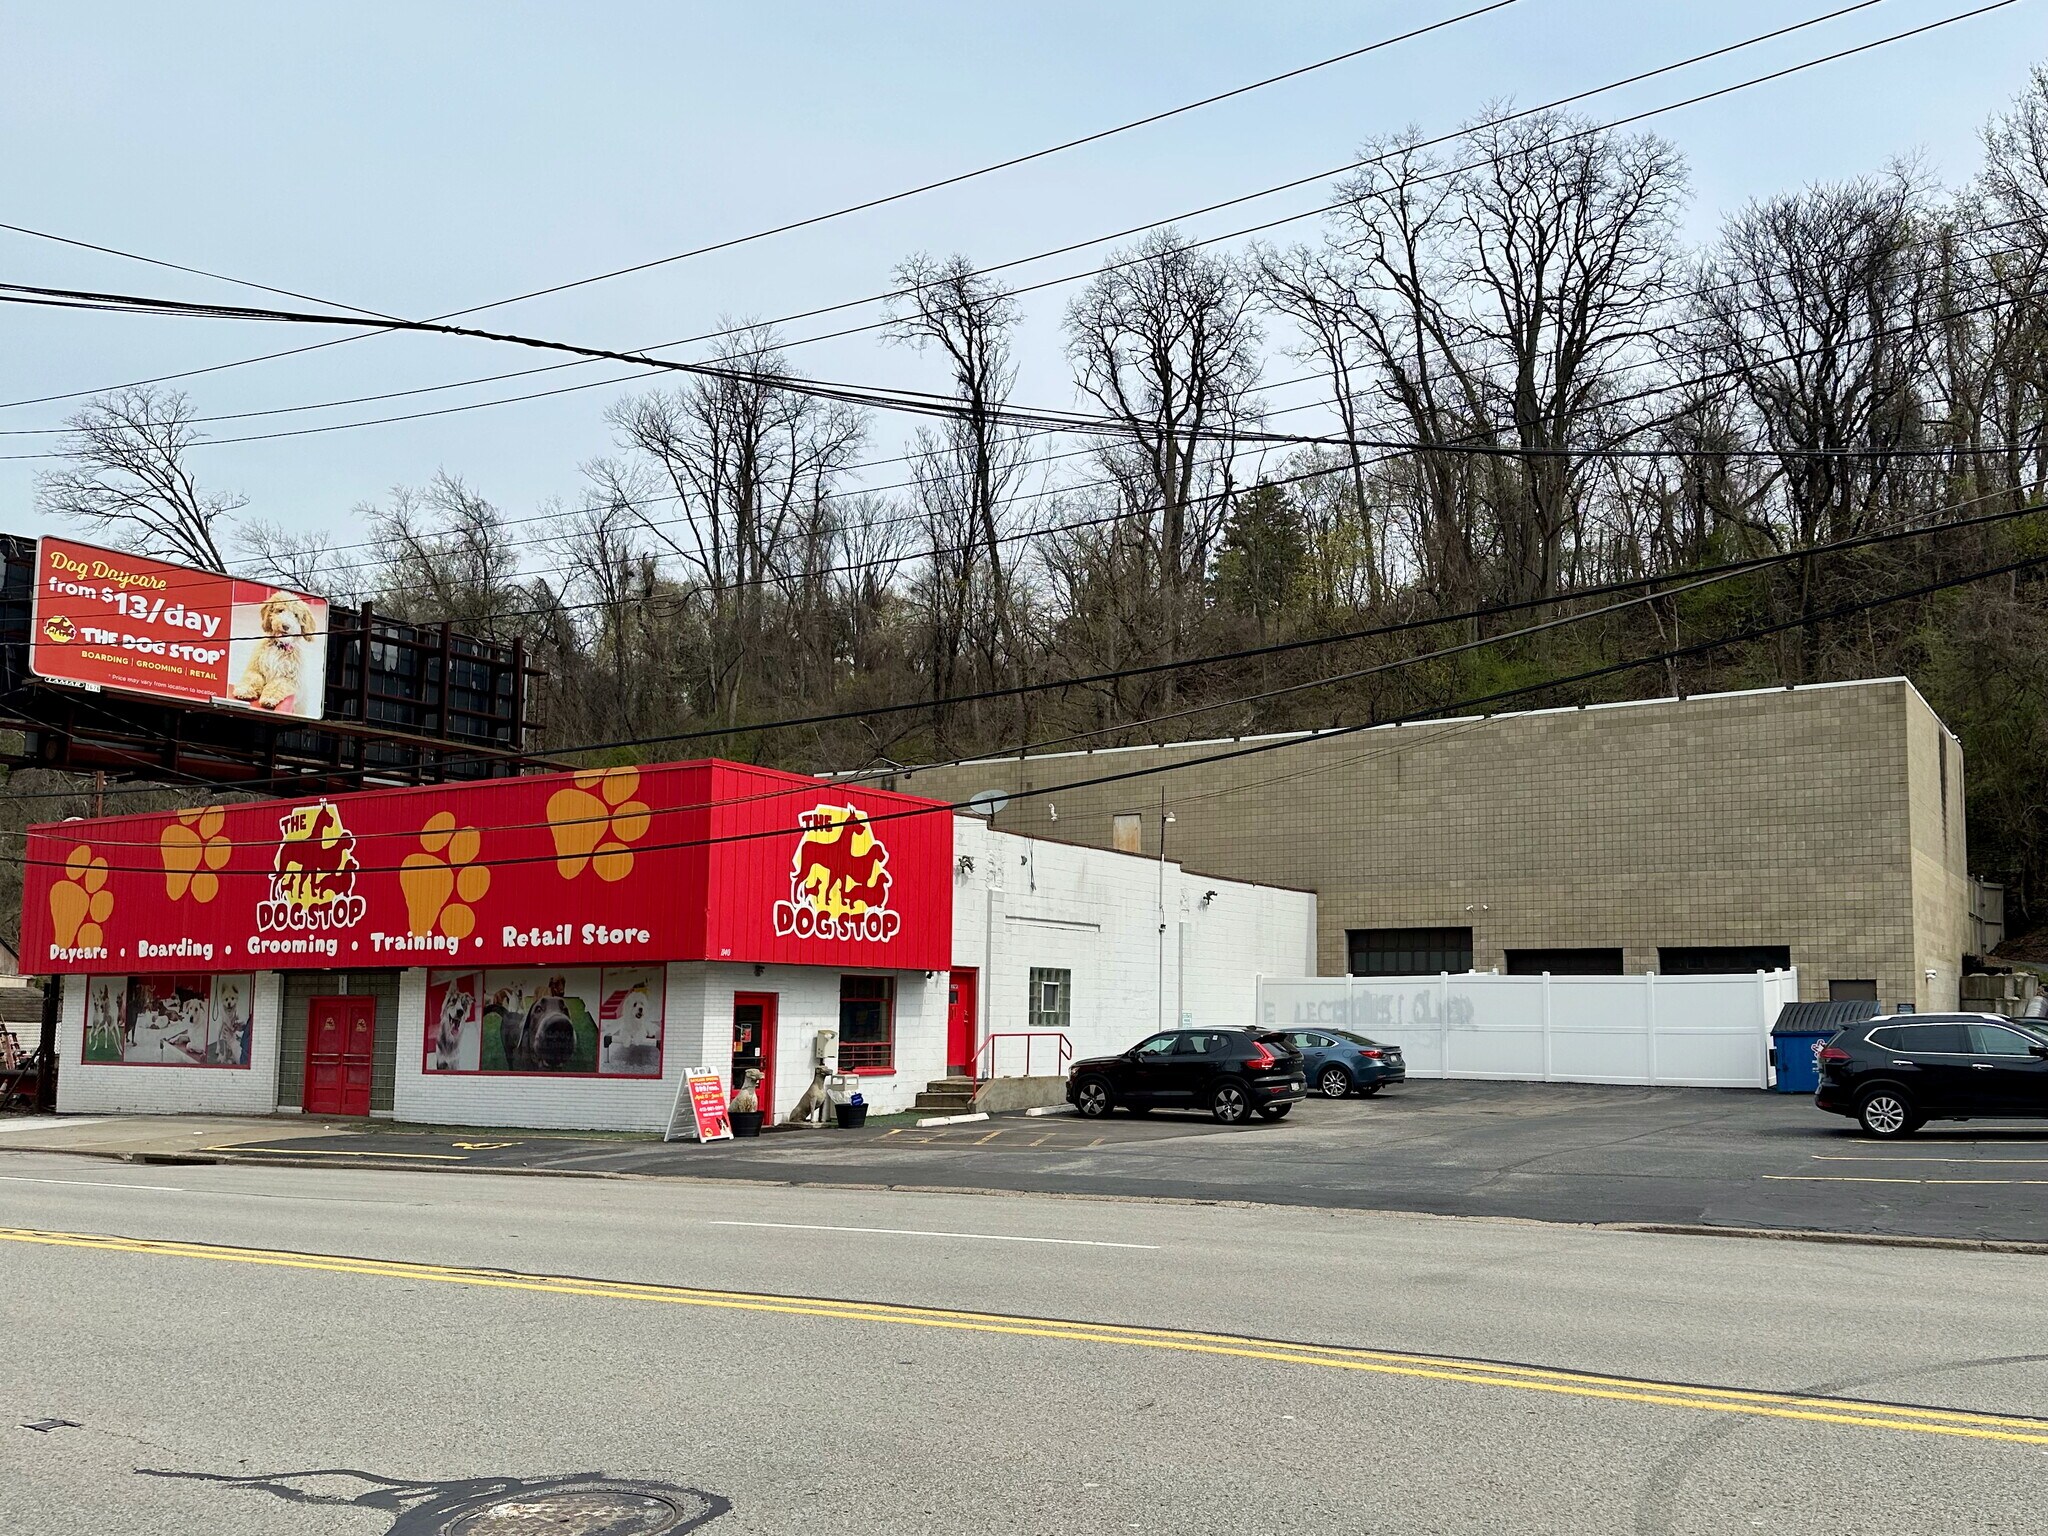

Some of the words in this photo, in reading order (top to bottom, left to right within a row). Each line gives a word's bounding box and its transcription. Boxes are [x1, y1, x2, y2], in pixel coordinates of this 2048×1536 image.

[50, 551, 88, 580] Dog
[92, 560, 167, 590] Daycare
[49, 576, 96, 599] from
[101, 586, 222, 638] $13/day
[80, 627, 118, 647] THE
[122, 634, 165, 655] DOG
[81, 650, 128, 665] BOARDING
[136, 659, 182, 674] GROOMING
[189, 669, 217, 680] RETAIL
[48, 677, 82, 687] LAMAR
[112, 674, 127, 682] Price
[140, 679, 152, 687] vary
[167, 682, 189, 692] location
[280, 813, 307, 835] THE
[801, 814, 833, 833] THE
[49, 943, 108, 964] Daycare
[138, 937, 213, 961] Boarding
[247, 934, 338, 957] Grooming
[370, 930, 459, 955] Training
[502, 924, 573, 948] Retail
[582, 923, 650, 945] Store
